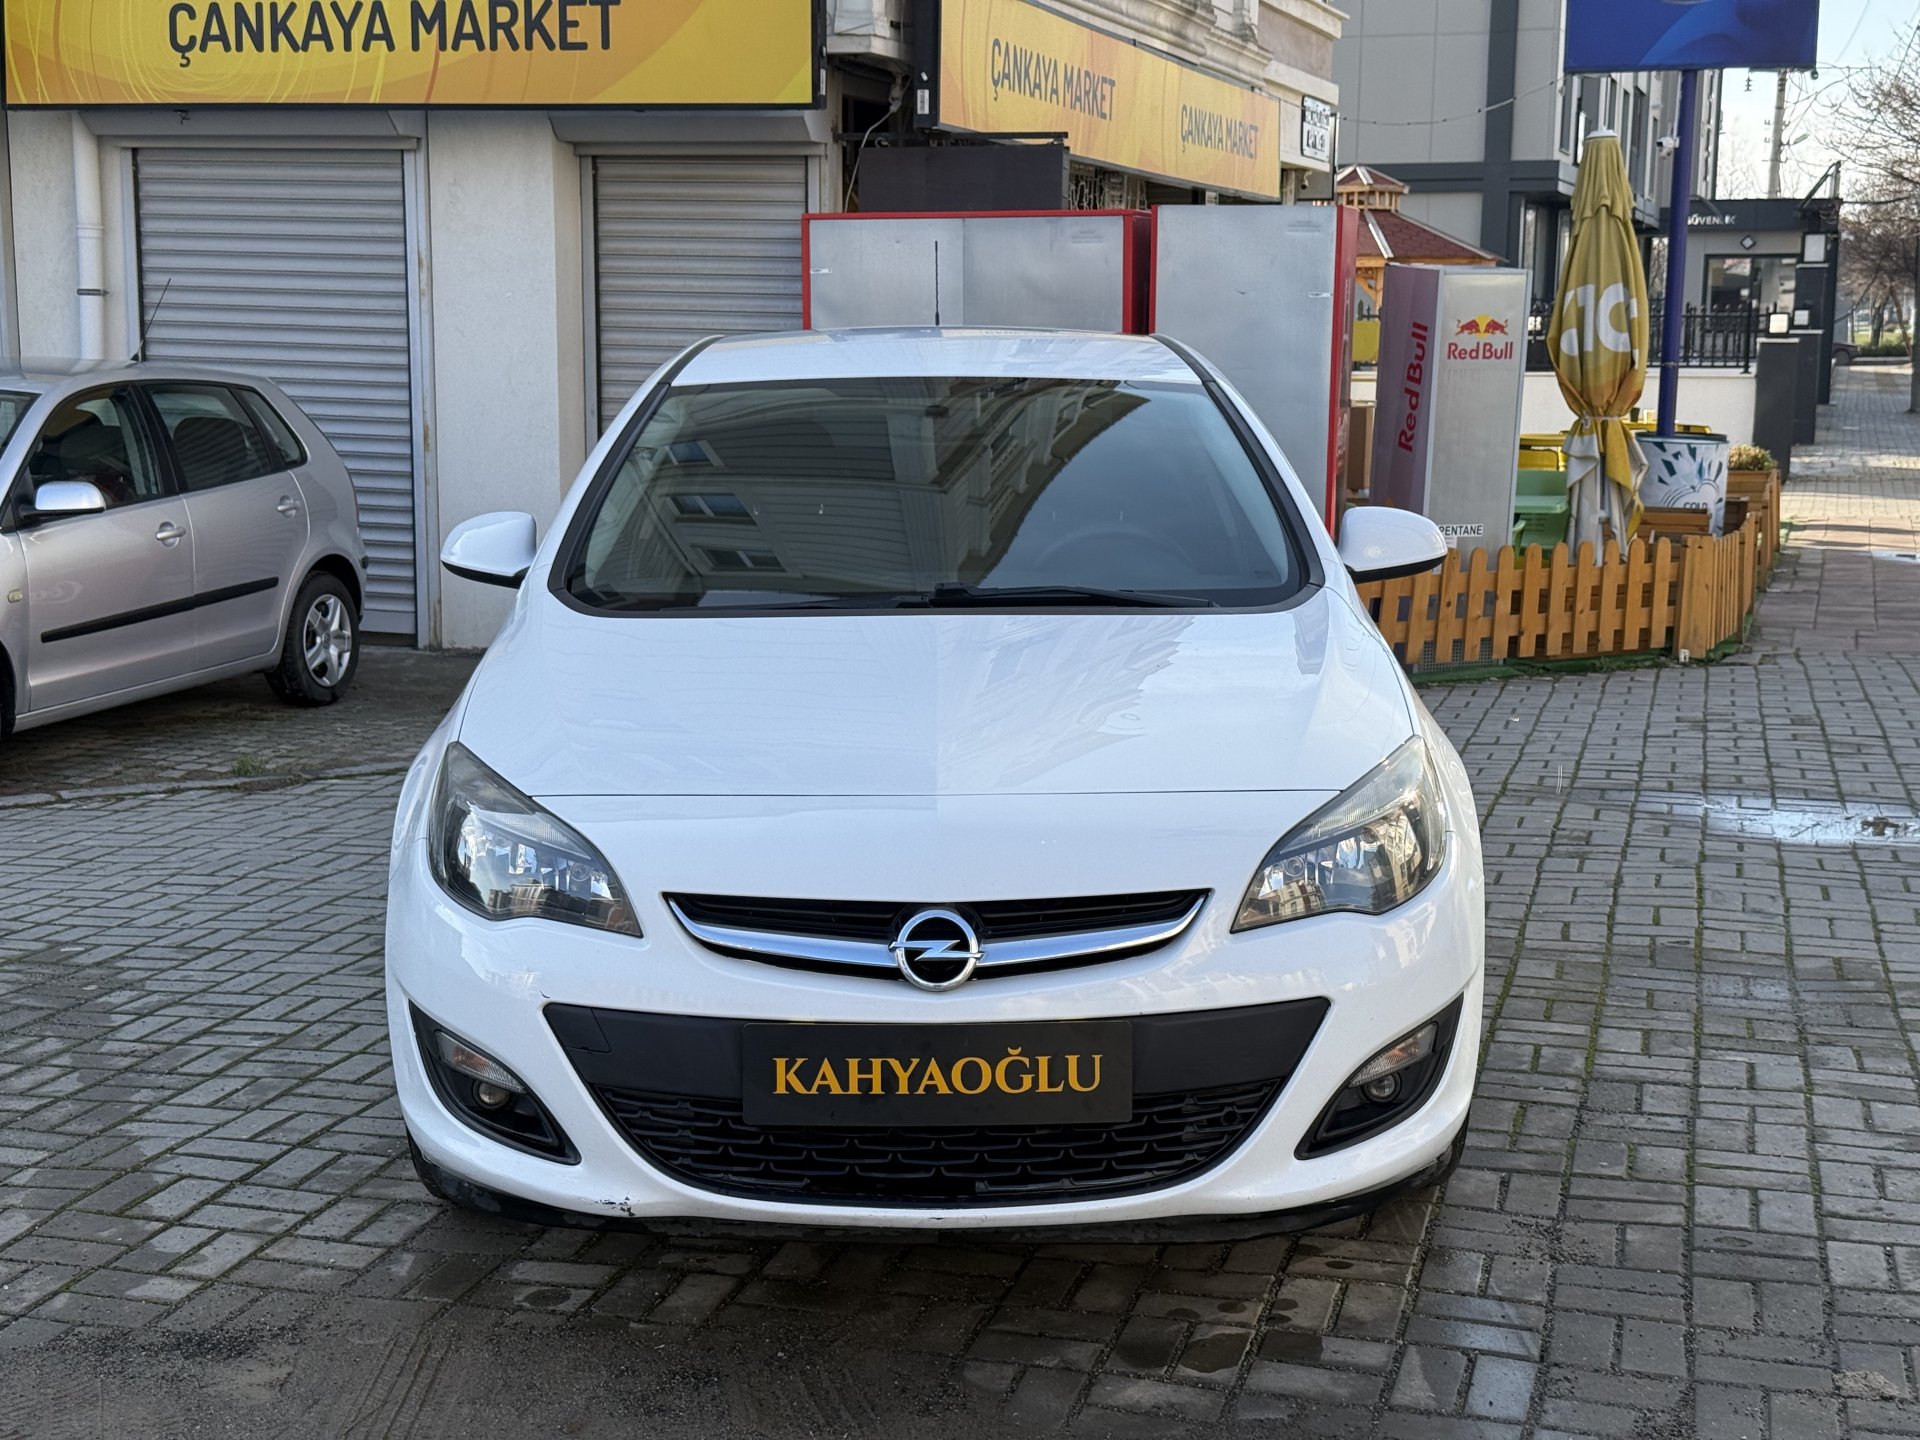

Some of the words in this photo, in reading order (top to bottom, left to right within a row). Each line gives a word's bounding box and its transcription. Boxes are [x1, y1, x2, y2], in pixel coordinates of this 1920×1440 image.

[169, 1, 396, 67] ÇANKAYA
[410, 0, 621, 51] MARKET
[991, 38, 1059, 102] ÇANKAYA
[1063, 62, 1116, 121] MARKET
[1181, 104, 1223, 153] ÇANKAYA
[1225, 117, 1258, 160] MARKET
[1406, 321, 1429, 385] Bull
[1447, 341, 1480, 360] Red
[1482, 341, 1514, 360] Bull
[1397, 387, 1420, 452] Red
[772, 1046, 1103, 1095] KAHYAOĞLU
